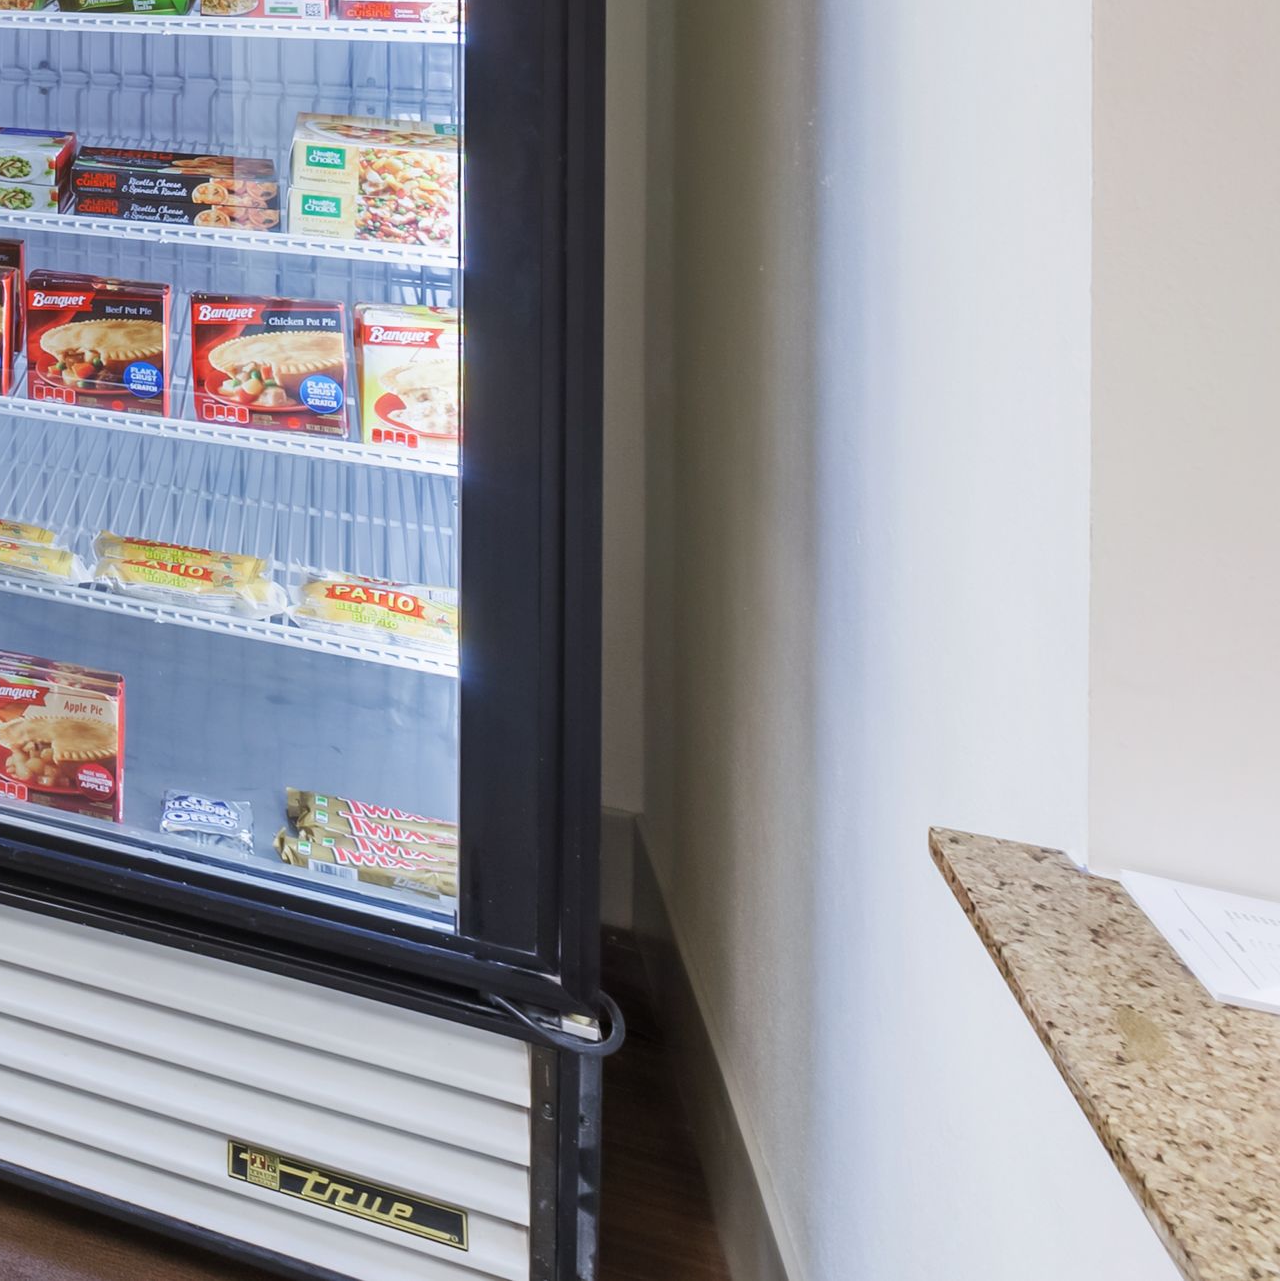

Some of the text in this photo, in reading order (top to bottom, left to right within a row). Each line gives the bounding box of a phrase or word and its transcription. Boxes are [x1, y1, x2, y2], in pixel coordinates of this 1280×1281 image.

[308, 156, 342, 165] Choice
[156, 179, 182, 188] Cheese
[128, 187, 160, 196] Spinach
[308, 198, 336, 208] Healthy
[158, 205, 184, 215] Cheese
[304, 204, 338, 214] Choice
[130, 213, 161, 222] Spinach
[32, 291, 86, 309] Banquet
[105, 305, 152, 316] Beef Pot Pie
[198, 304, 256, 322] Banquet
[268, 317, 337, 328] Chicken Pot Pie
[130, 367, 158, 376] FLAKY
[131, 374, 157, 382] CRUST
[130, 382, 158, 393] SCRATCH
[306, 380, 337, 390] FLAKY
[307, 387, 336, 396] CRUST
[306, 398, 337, 408] SCRATCH
[335, 584, 416, 612] PATIO
[351, 611, 399, 630] Burrito
[64, 699, 104, 716] Apple Pie
[81, 780, 110, 794] APPLES
[164, 800, 238, 818] KLONDIKE
[165, 812, 237, 829] OREO
[354, 835, 440, 861] TWIX
[333, 845, 417, 870] TWIX
[296, 1170, 425, 1228] true
